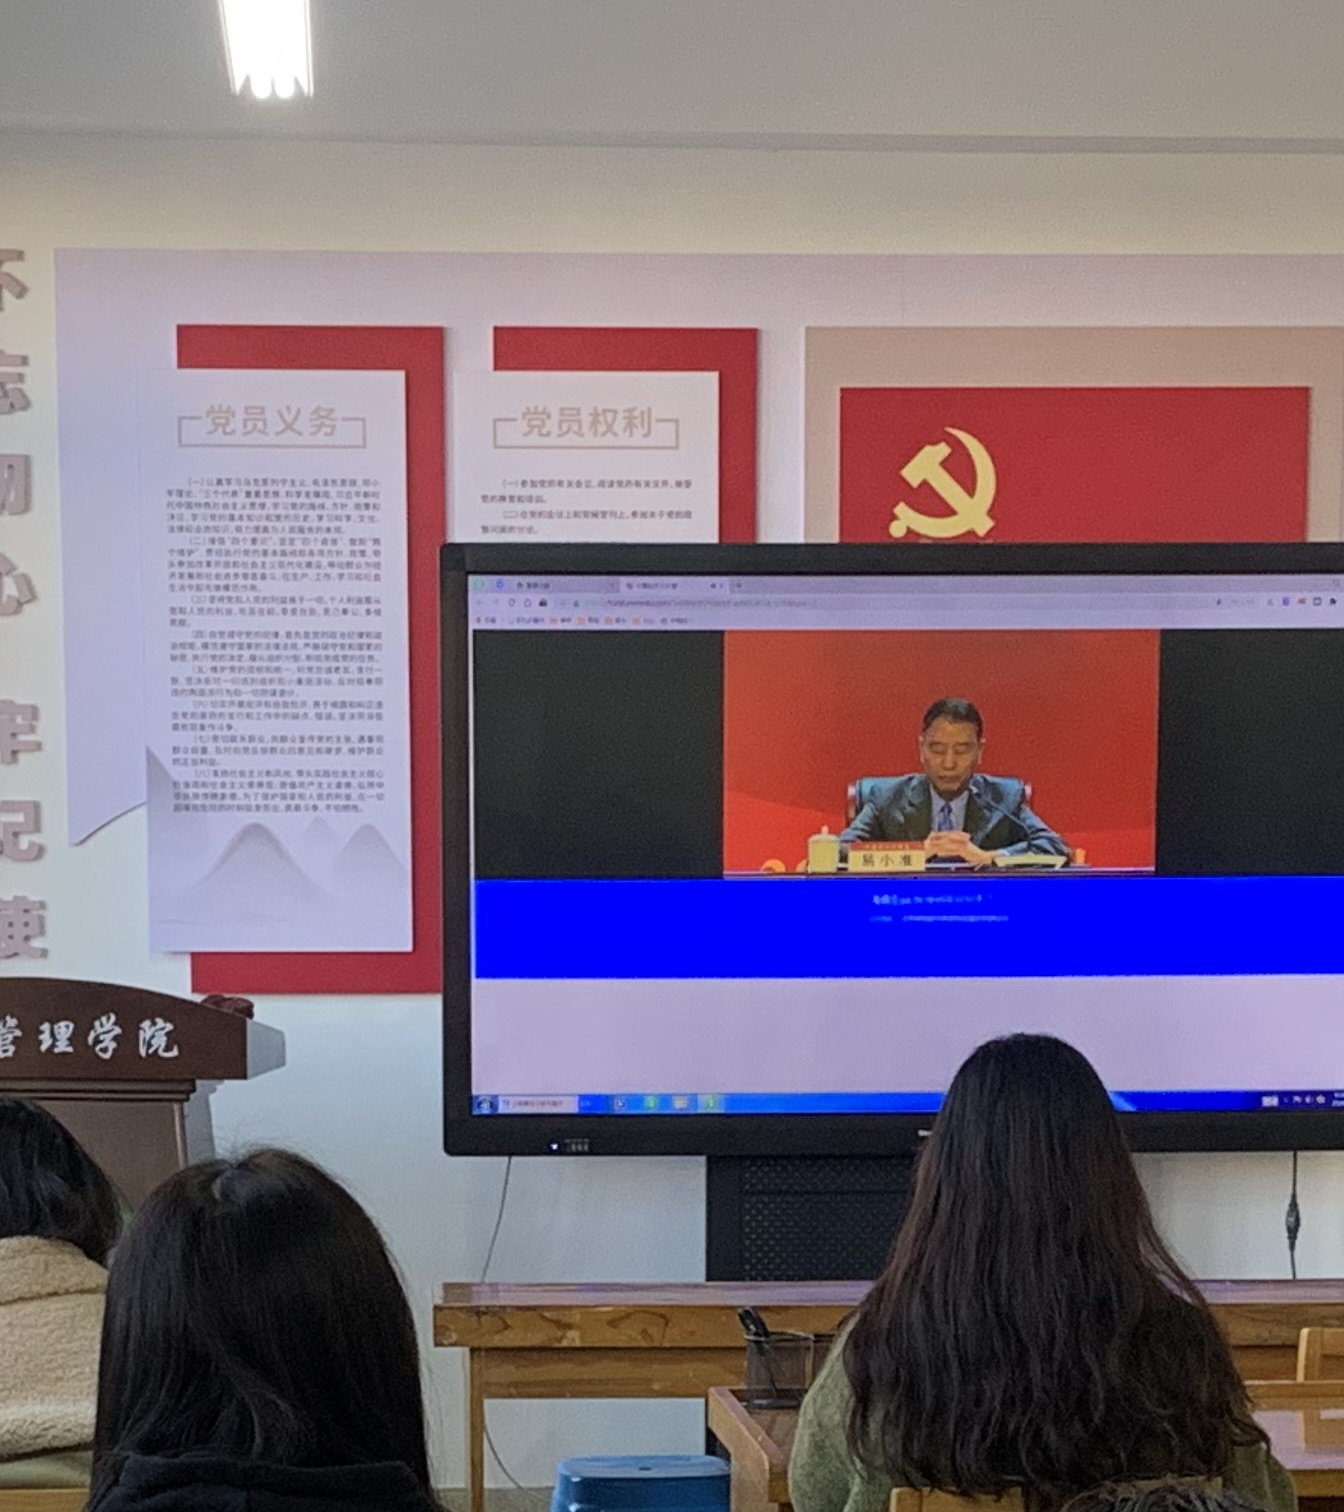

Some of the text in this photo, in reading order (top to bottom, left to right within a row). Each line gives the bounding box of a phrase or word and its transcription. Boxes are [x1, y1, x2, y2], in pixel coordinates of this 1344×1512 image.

[205, 403, 339, 437] 党员义务
[521, 406, 653, 438] 党员权利
